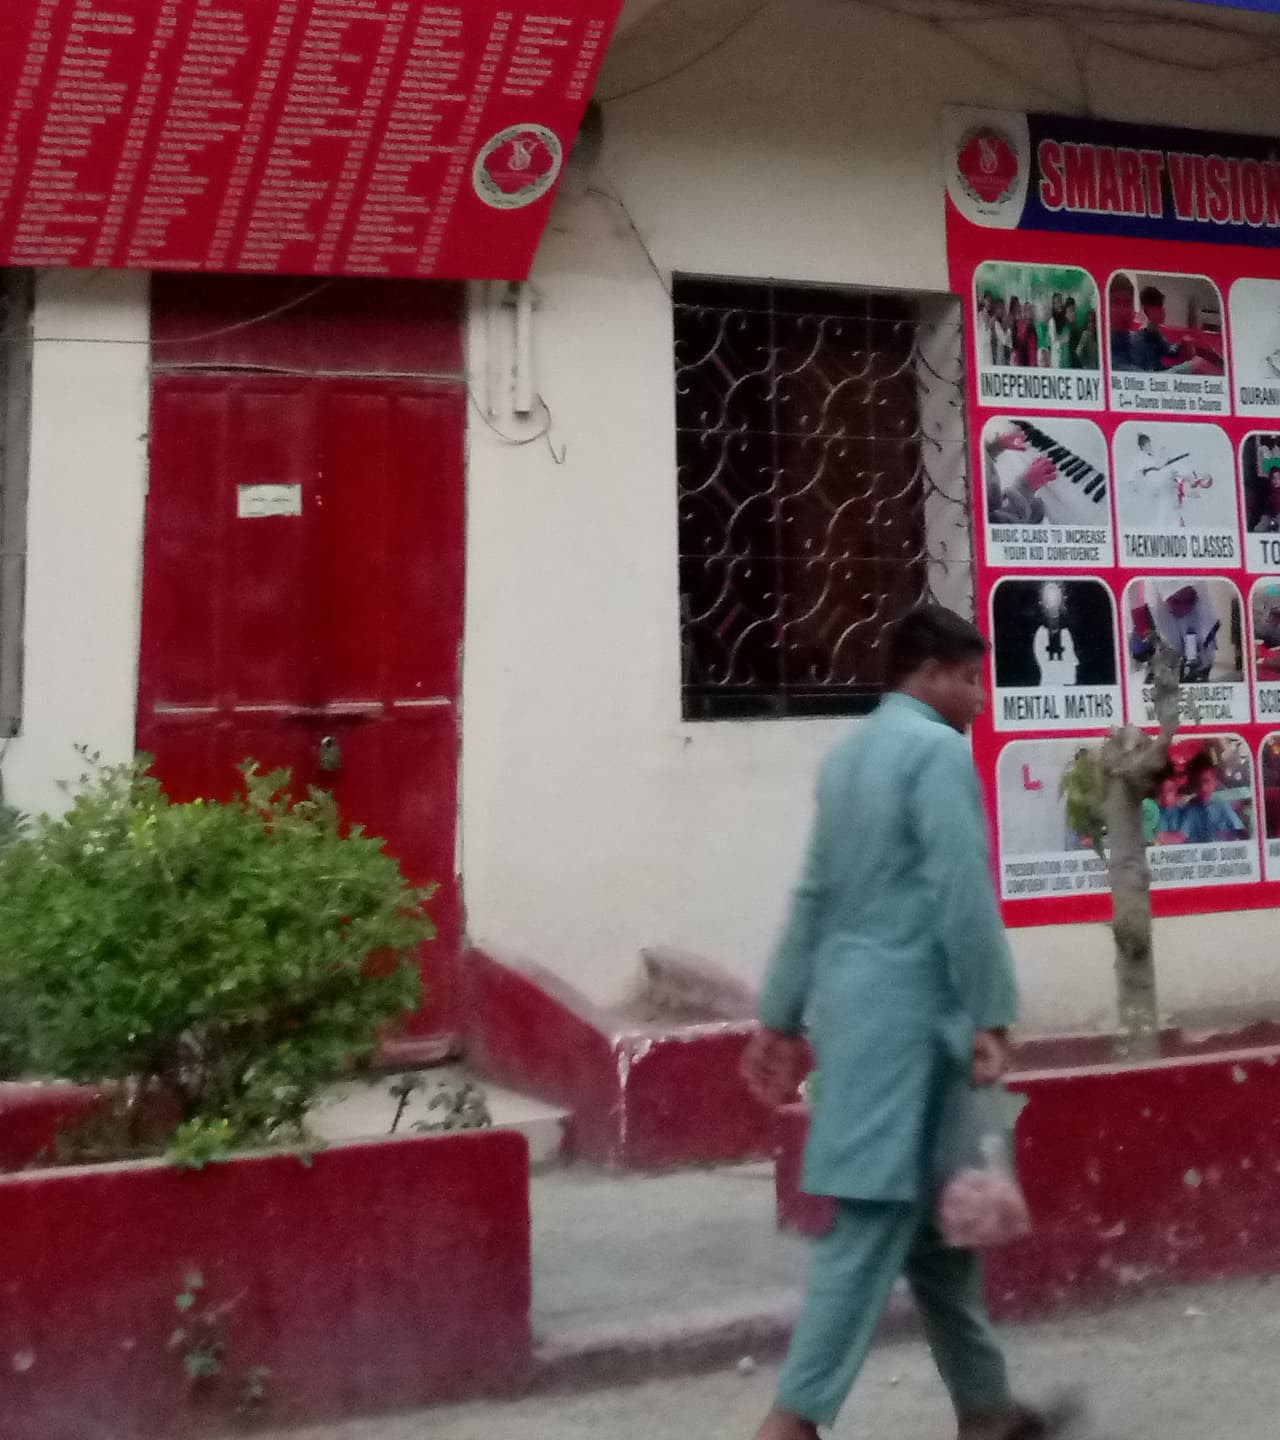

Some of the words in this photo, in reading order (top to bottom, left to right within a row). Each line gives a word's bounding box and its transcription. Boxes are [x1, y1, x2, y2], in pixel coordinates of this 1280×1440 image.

[1038, 139, 1164, 219] SMART
[980, 372, 1072, 400] INDEPENDENCE
[1077, 377, 1100, 401] DAY
[992, 528, 1018, 543] MUSIC
[1022, 528, 1048, 544] CLASS
[1051, 529, 1062, 544] TO
[1065, 530, 1106, 544] INCREASE
[1124, 533, 1187, 558] TAEKWONDO
[1191, 534, 1234, 558] CLASSES
[1004, 546, 1028, 561] YOUR
[1029, 546, 1044, 561] KID
[1046, 546, 1100, 561] CONFIDENCE
[1003, 695, 1059, 720] MENTAL
[1064, 693, 1113, 719] MATHS
